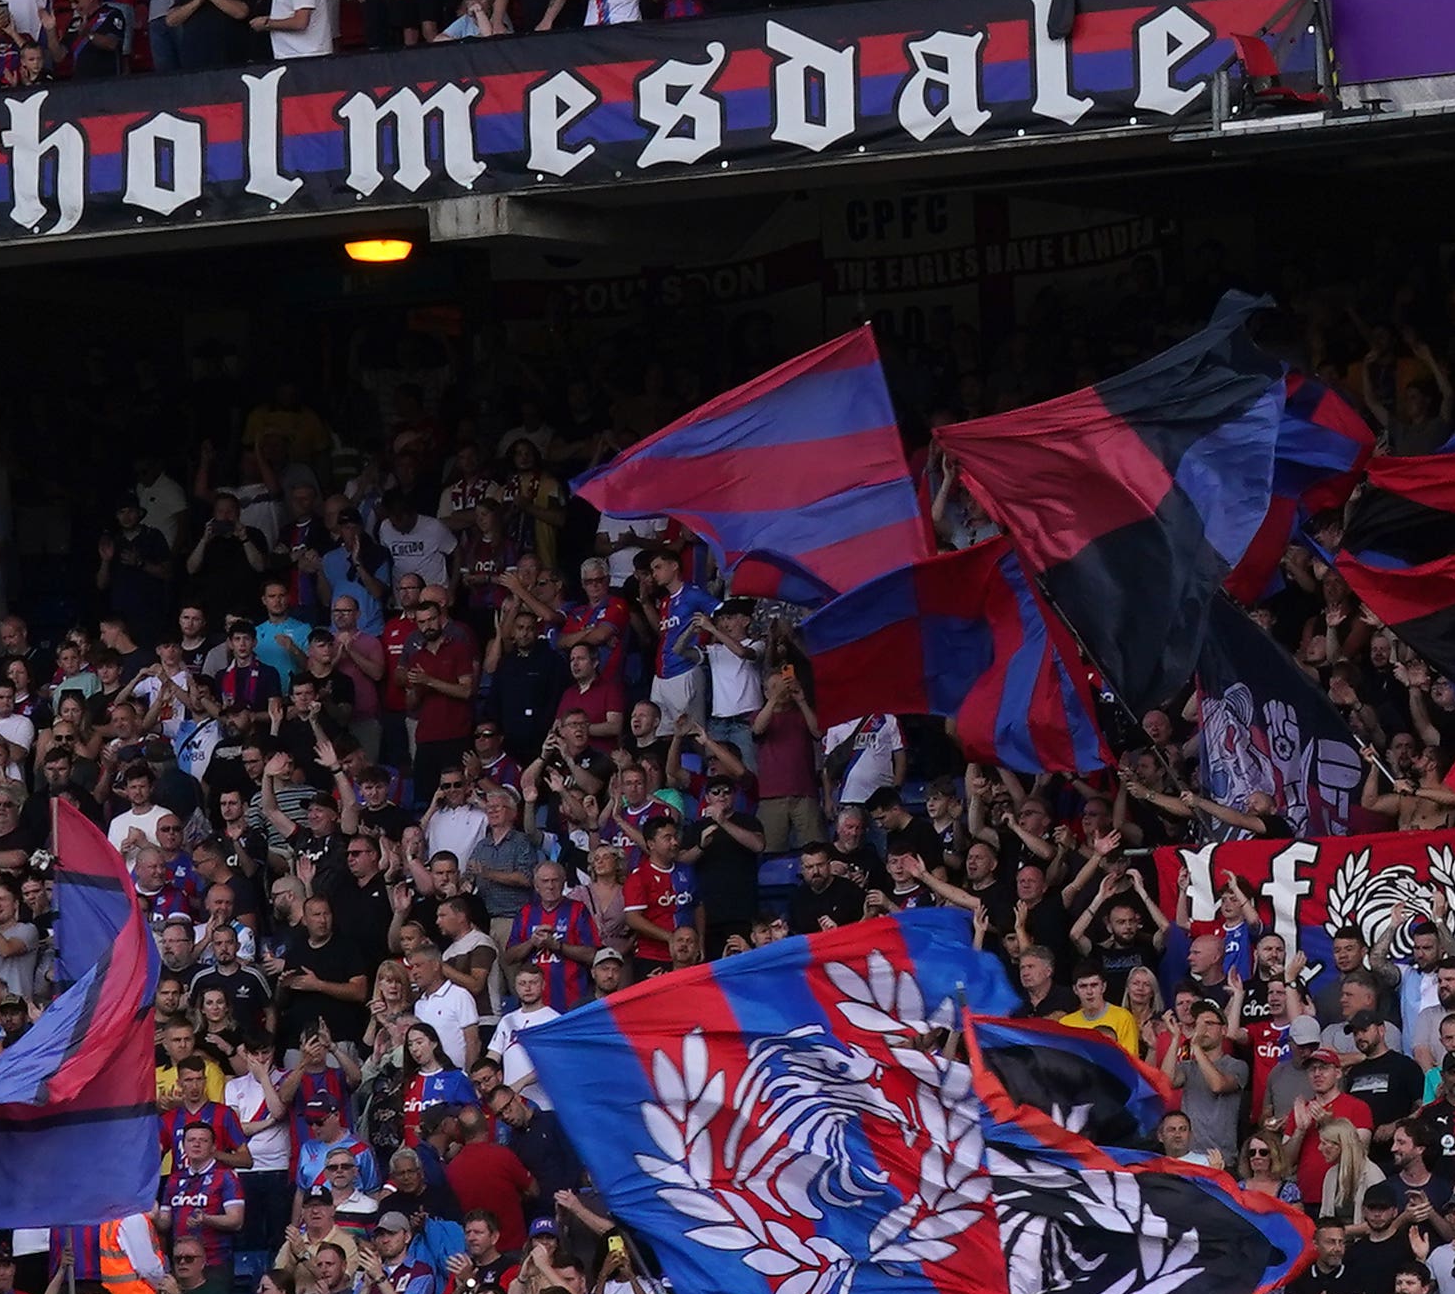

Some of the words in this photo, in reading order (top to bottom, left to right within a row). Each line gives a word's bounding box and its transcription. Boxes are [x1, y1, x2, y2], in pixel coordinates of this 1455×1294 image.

[846, 196, 947, 243] CPFC
[833, 255, 879, 296] THE
[886, 247, 981, 293] EAGLES
[981, 236, 1053, 281] HAVE
[658, 892, 692, 907] cinch
[1243, 1003, 1270, 1017] cinc
[171, 1191, 207, 1207] cinch
